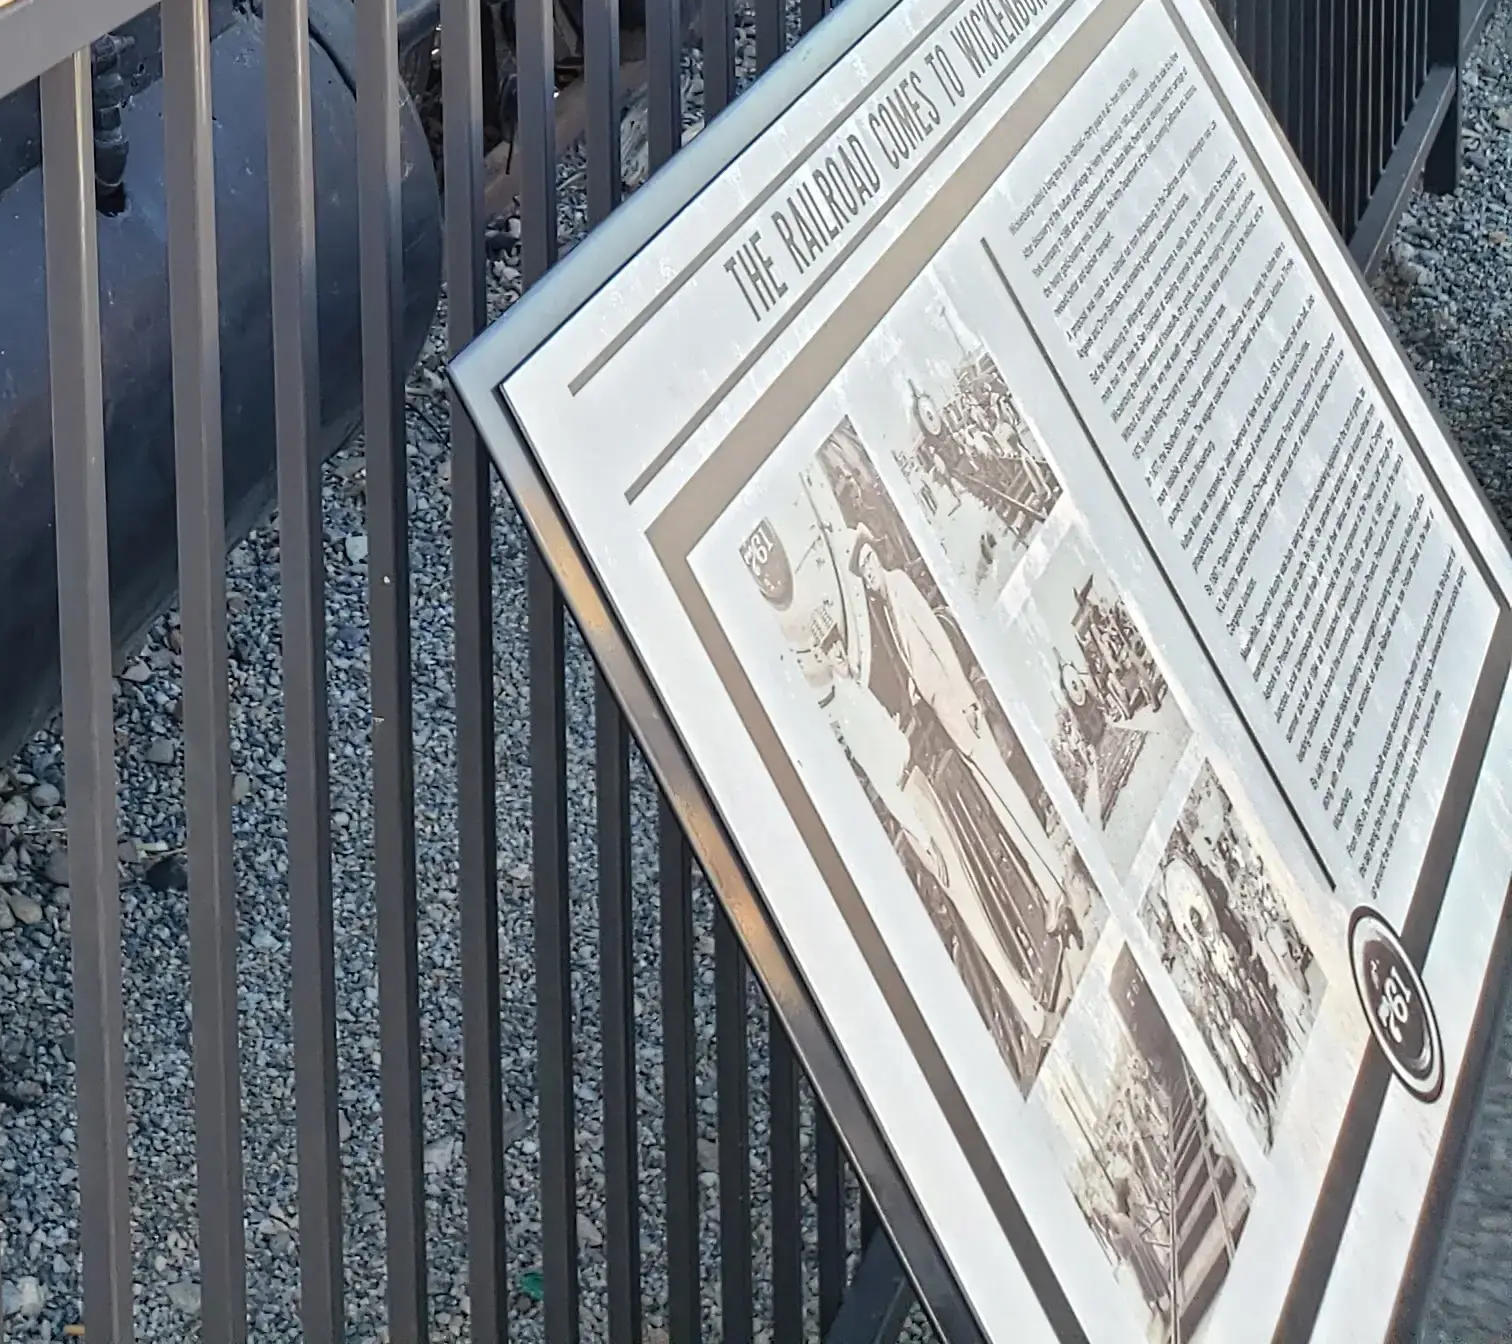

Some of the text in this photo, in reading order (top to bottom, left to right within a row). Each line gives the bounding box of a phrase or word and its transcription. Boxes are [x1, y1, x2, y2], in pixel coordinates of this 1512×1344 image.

[724, 231, 789, 322] THE
[772, 132, 882, 274] RAILROAD
[869, 71, 942, 170] COMES
[924, 43, 966, 108] TO
